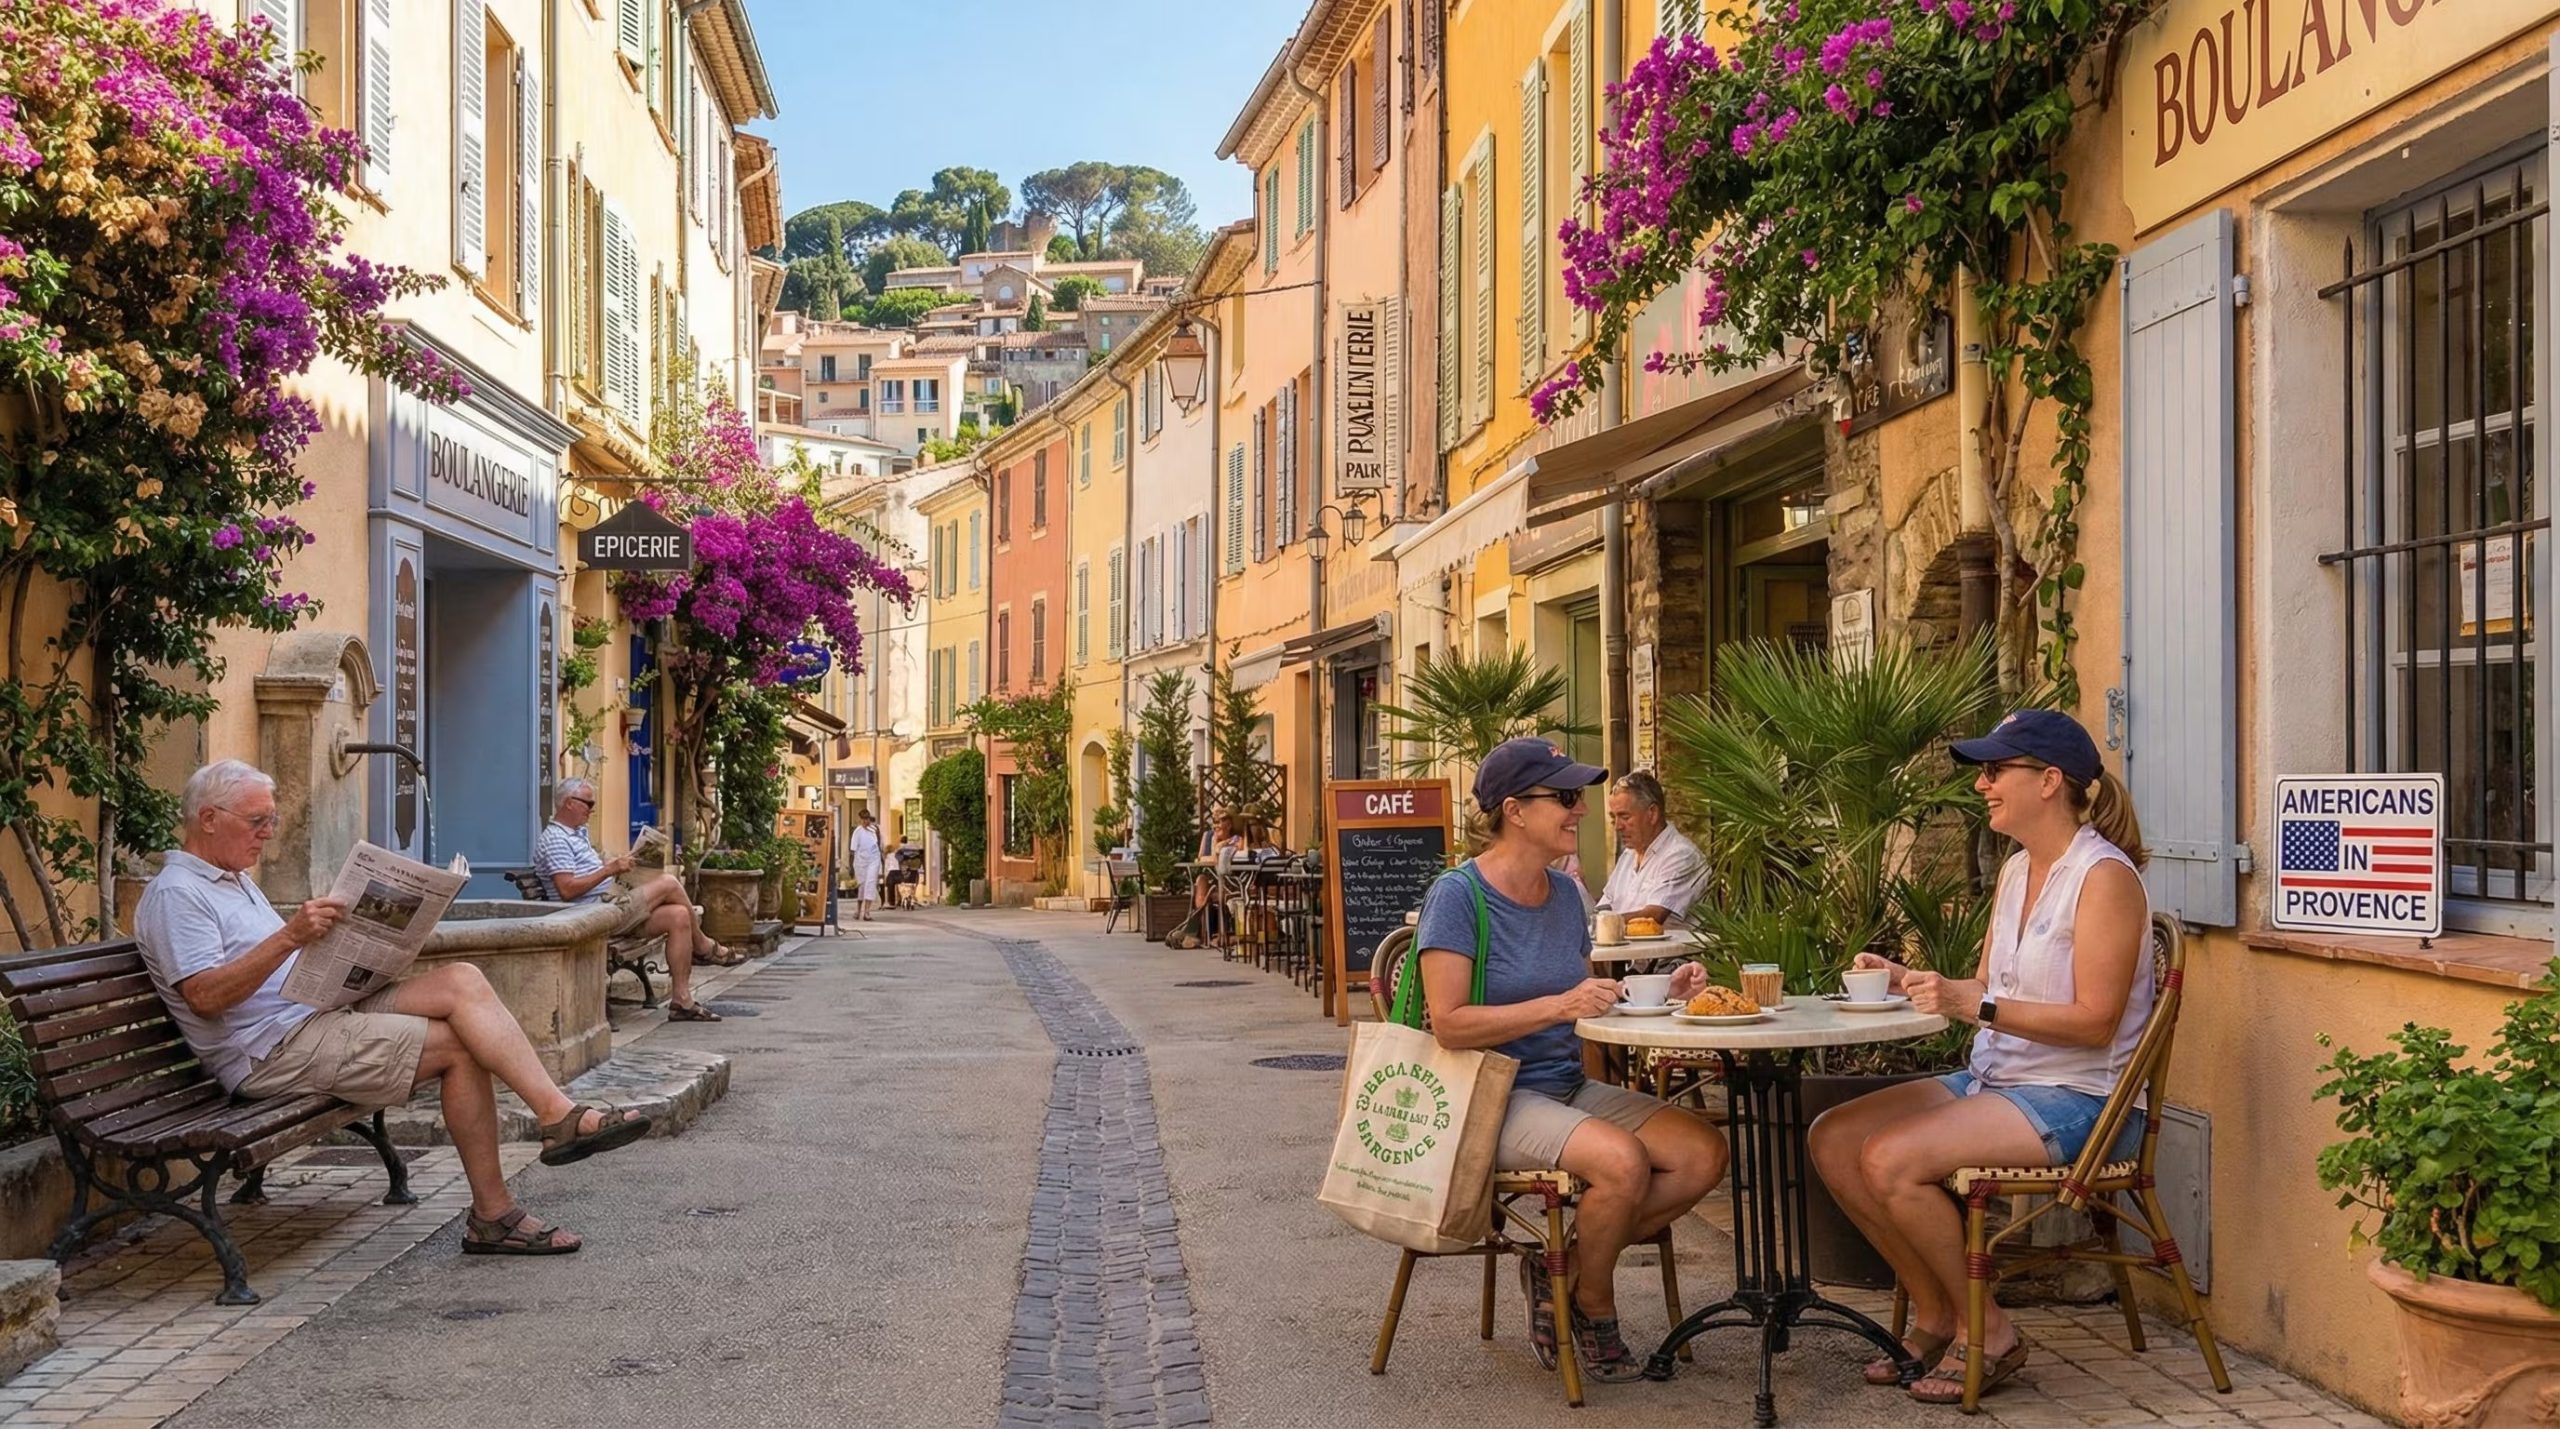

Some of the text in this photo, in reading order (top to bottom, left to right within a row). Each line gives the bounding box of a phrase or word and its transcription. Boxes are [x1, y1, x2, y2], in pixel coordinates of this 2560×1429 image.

[430, 431, 528, 518] BOULANGERIE
[594, 535, 681, 558] EPICERIE
[1365, 790, 1415, 815] CAFÉ
[2282, 788, 2434, 815] AMERICANS
[2343, 844, 2368, 871] IN
[2286, 890, 2426, 922] PROVENCE
